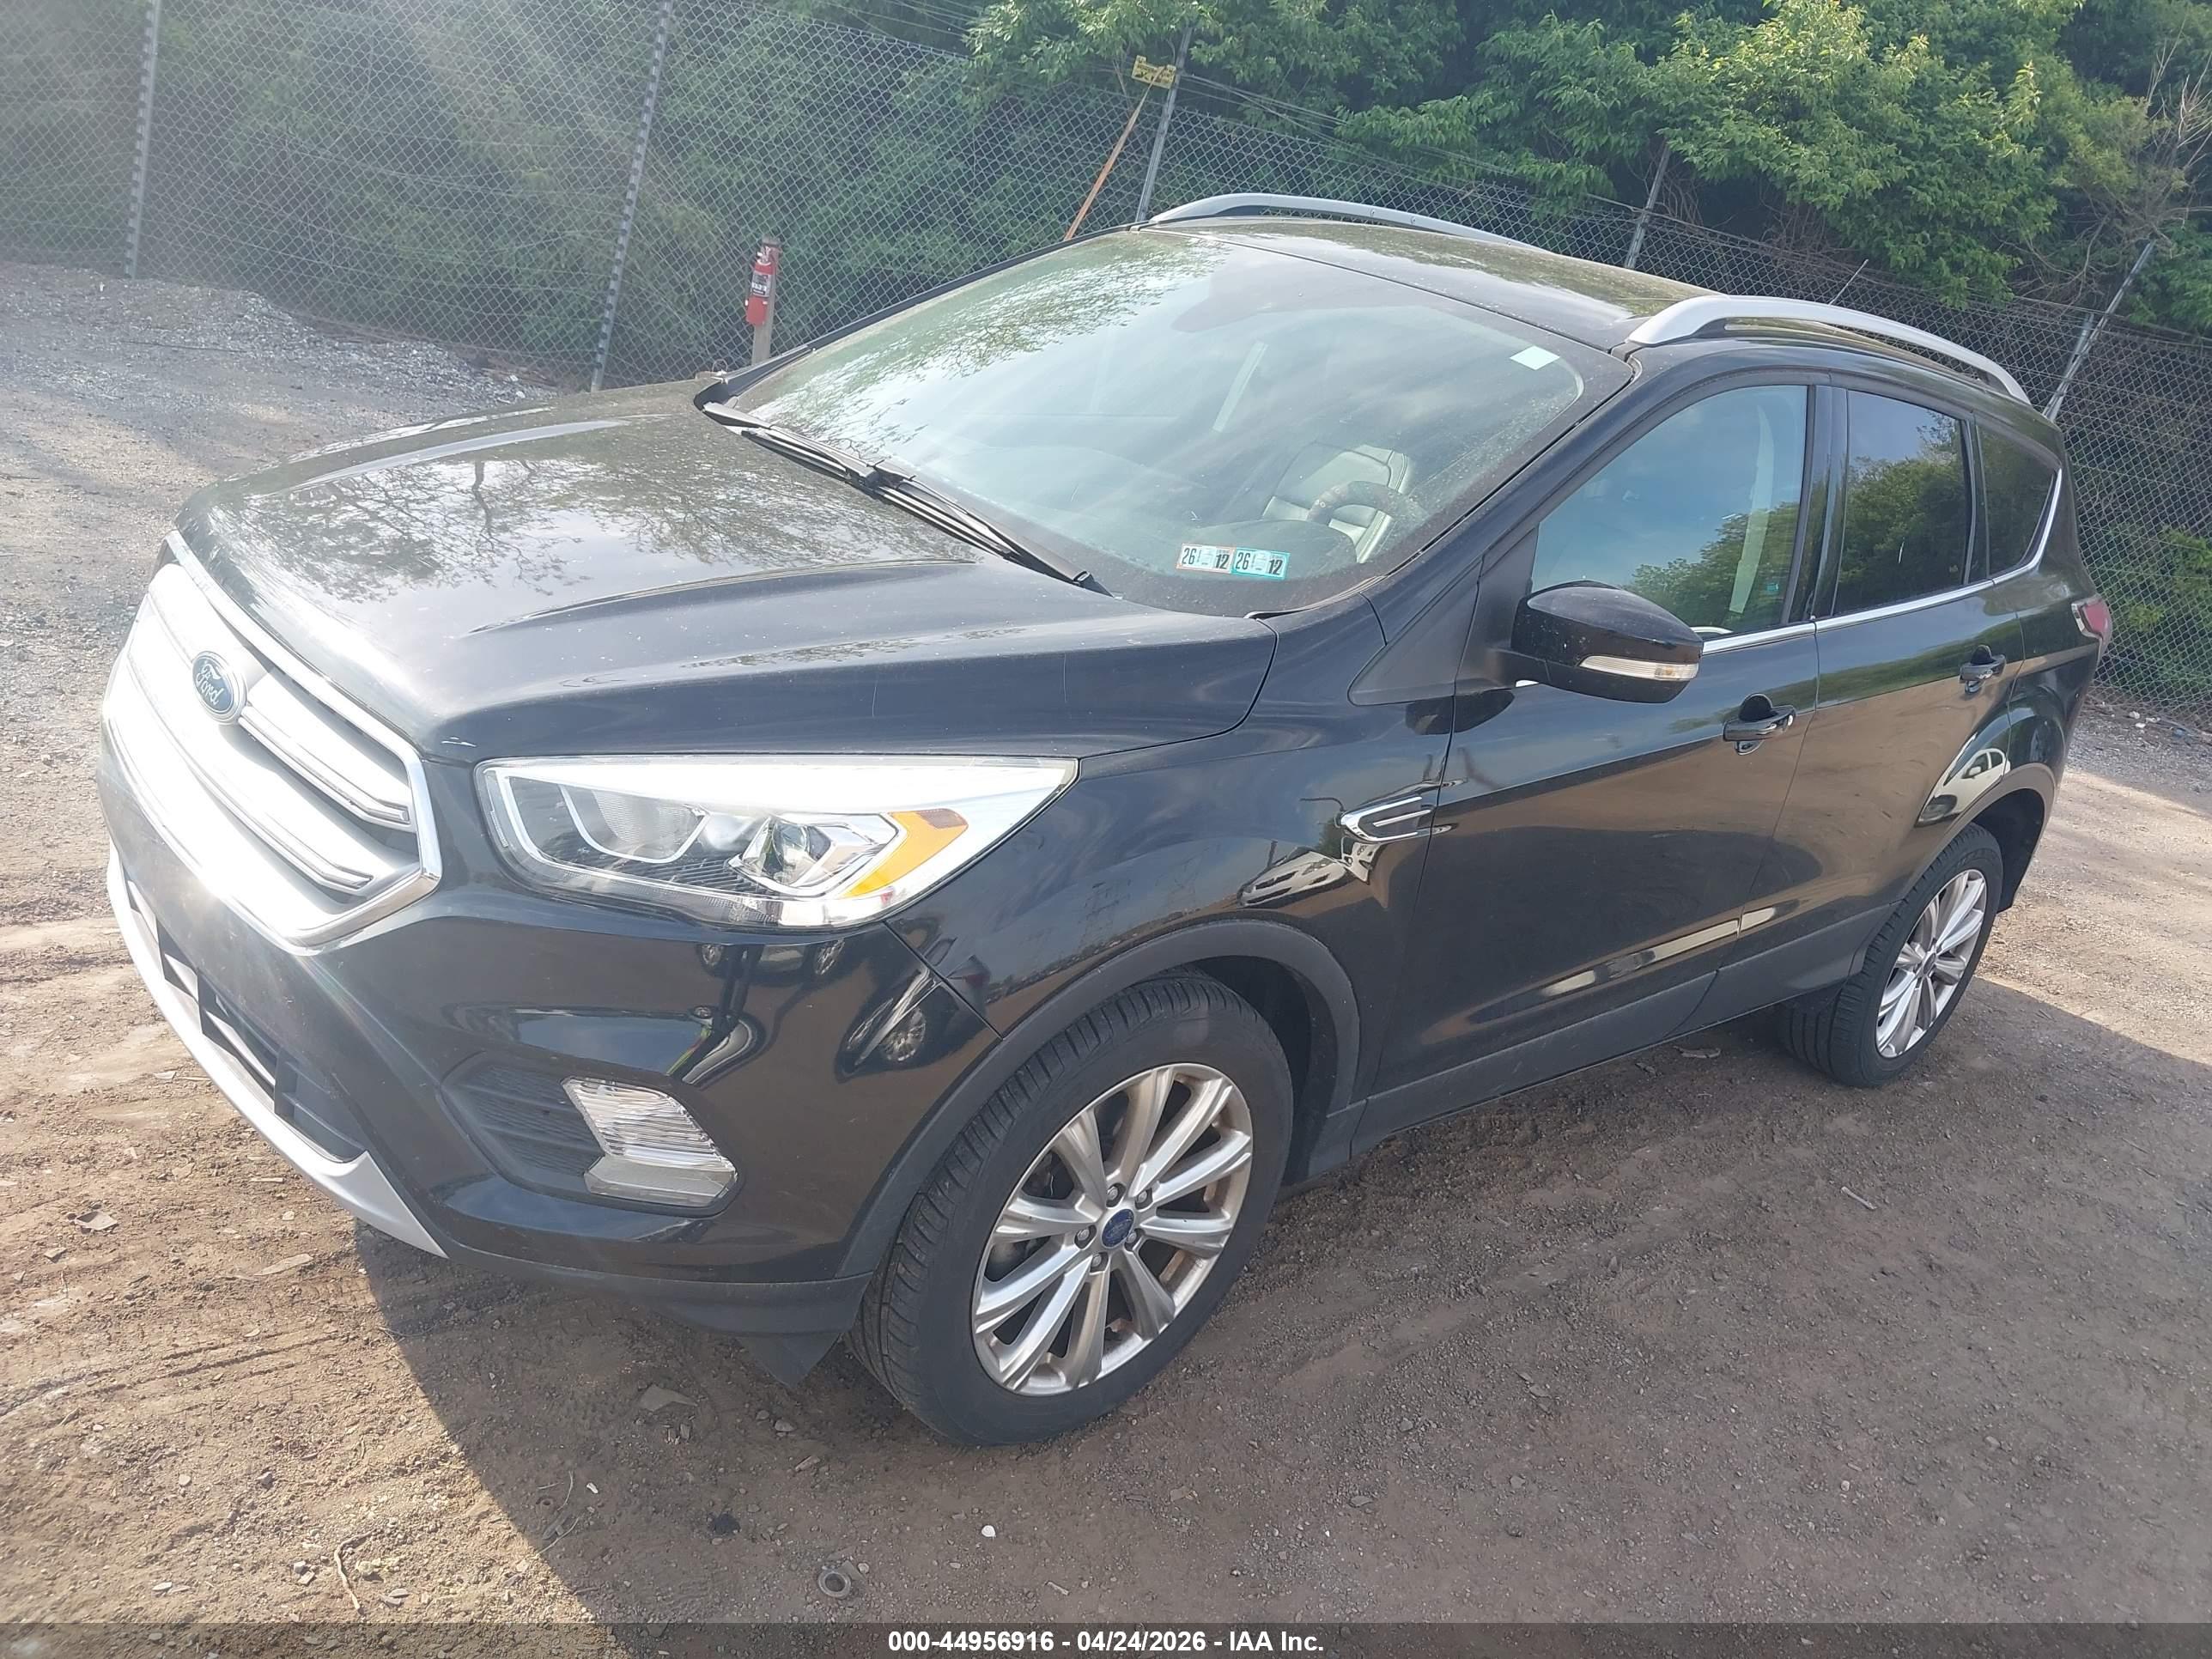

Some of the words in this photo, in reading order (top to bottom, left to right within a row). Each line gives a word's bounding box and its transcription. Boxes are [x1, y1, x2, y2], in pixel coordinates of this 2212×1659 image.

[1182, 548, 1197, 565] 26
[1215, 554, 1230, 569] 12
[1236, 552, 1250, 570] 26
[1268, 559, 1283, 575] 12
[196, 661, 225, 706] Ford
